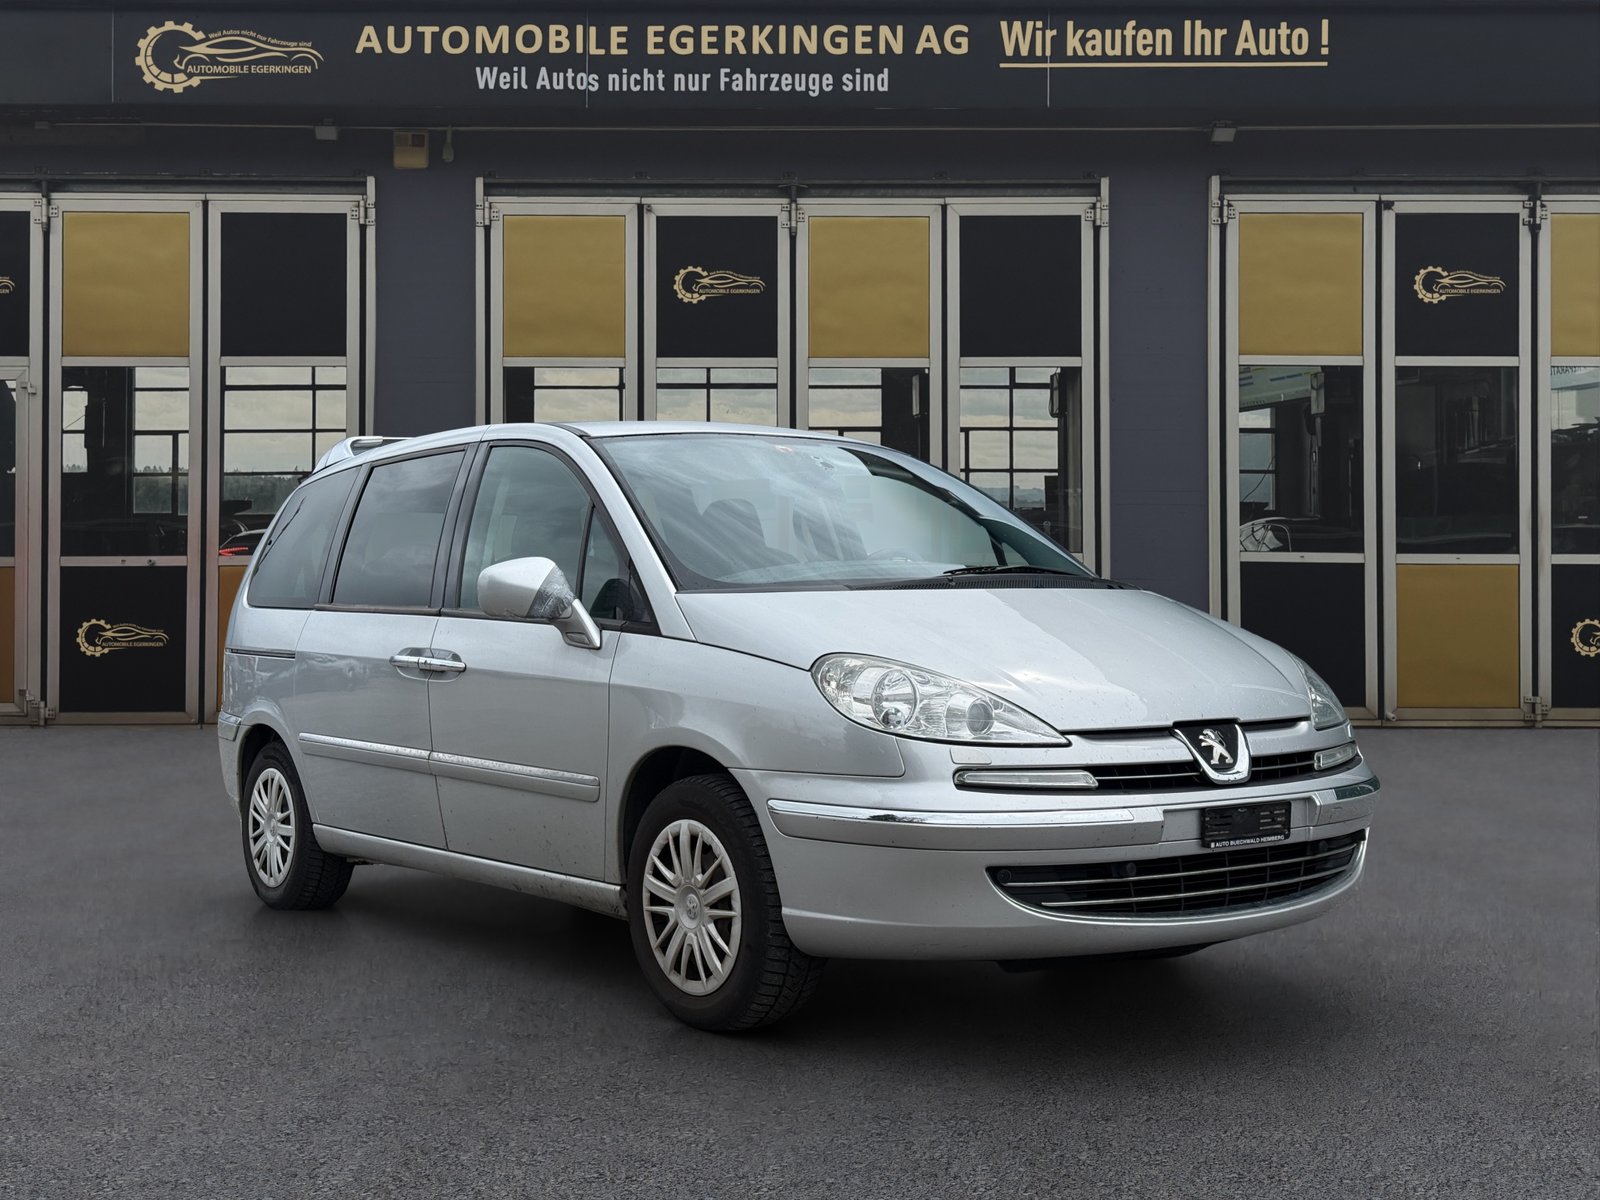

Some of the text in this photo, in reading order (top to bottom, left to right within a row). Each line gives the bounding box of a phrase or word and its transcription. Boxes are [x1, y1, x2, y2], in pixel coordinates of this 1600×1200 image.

[208, 30, 222, 40] Weil
[222, 29, 240, 37] Autos
[241, 29, 257, 39] nicht
[256, 33, 268, 42] nur
[267, 37, 298, 47] Fahrzeuge
[355, 24, 970, 56] AUTOMOBILE EGERKINGEN AG
[1000, 19, 1329, 57] Wir kaufen Ihr Auto !
[187, 65, 312, 74] AUTOMOBILE EGERKINGEN
[475, 66, 889, 97] Weil Autos nicht nur Fahrzeuge sind
